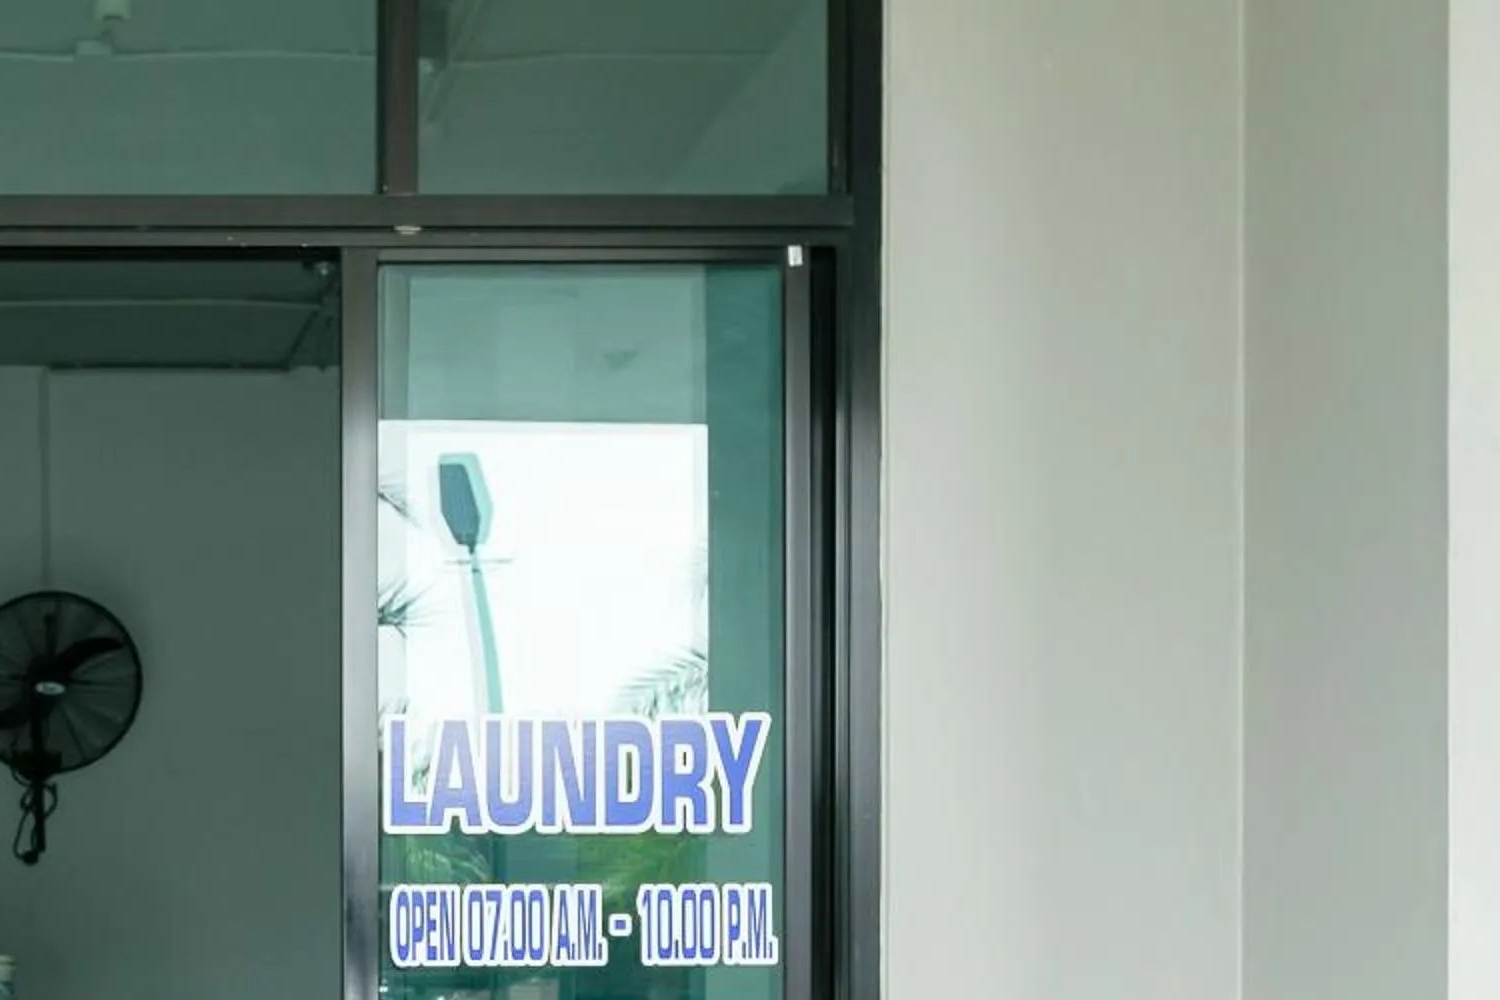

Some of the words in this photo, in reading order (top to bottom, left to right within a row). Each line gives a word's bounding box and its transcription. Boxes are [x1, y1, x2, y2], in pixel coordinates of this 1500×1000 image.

[389, 719, 764, 827] LAUNDRY
[395, 889, 456, 961] OPEN
[467, 889, 546, 961] 07.00
[556, 889, 603, 960] A.M.
[641, 888, 715, 960] 10.00
[727, 888, 774, 960] P.M.
